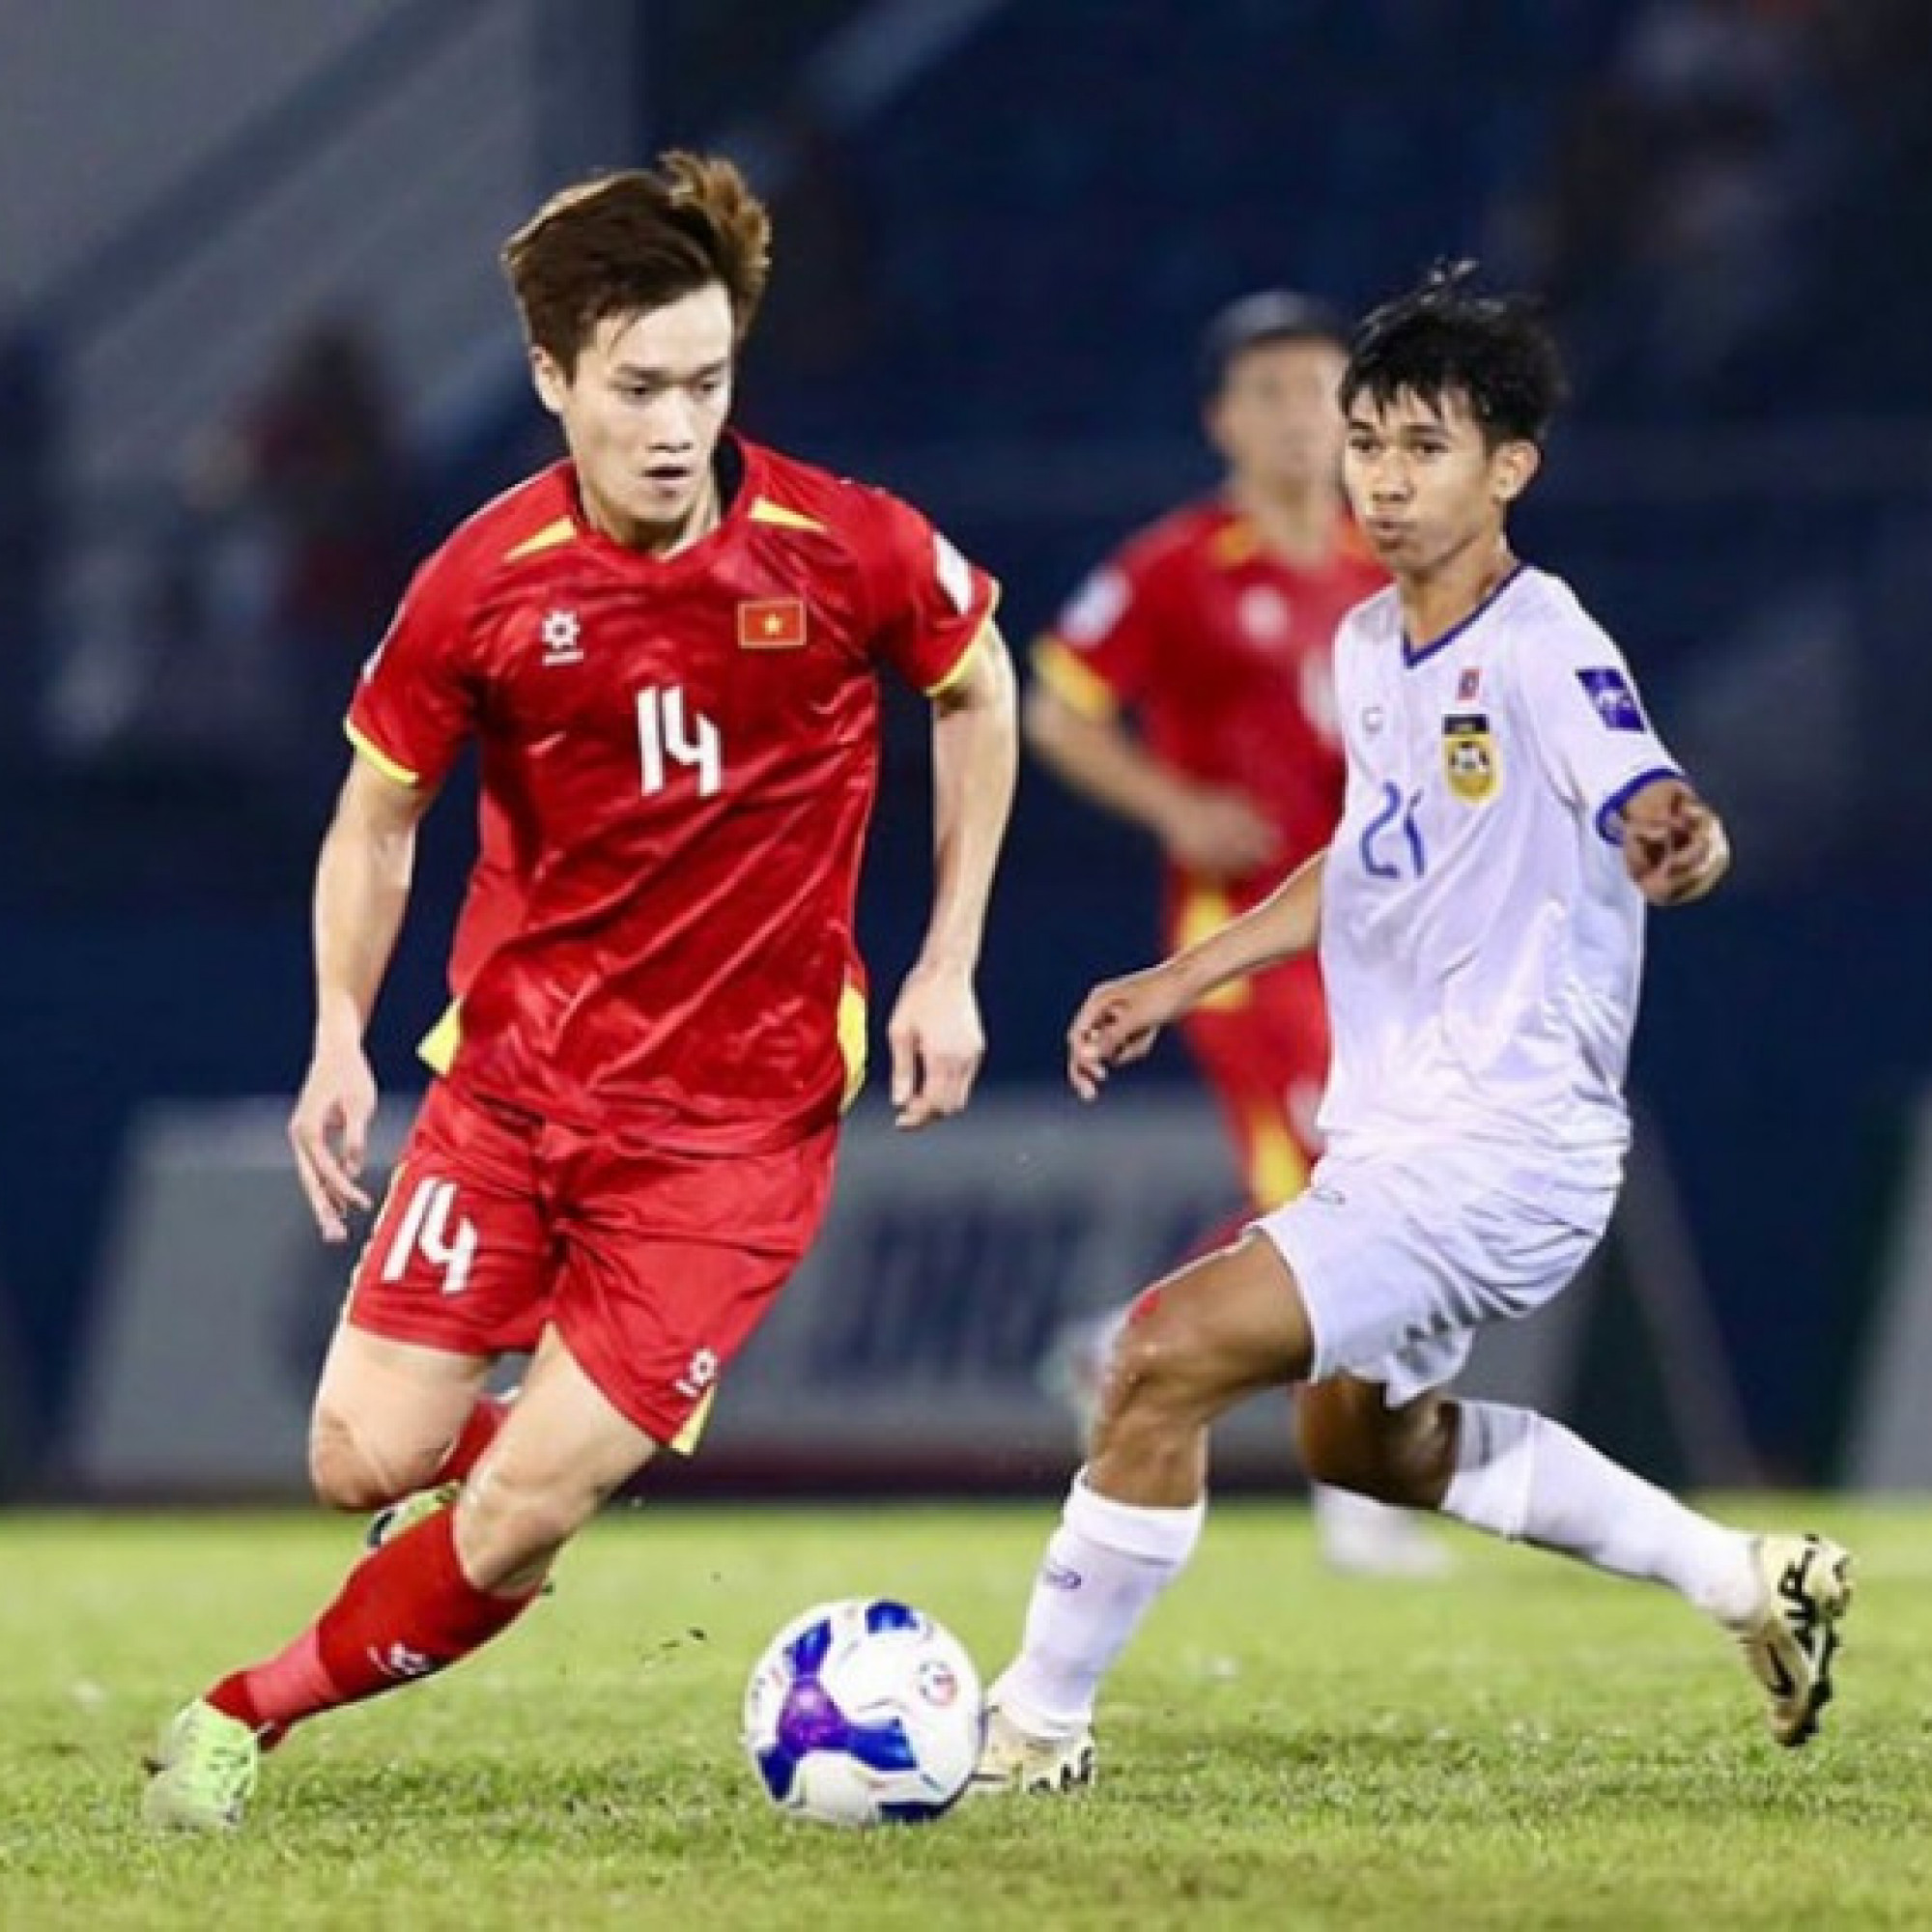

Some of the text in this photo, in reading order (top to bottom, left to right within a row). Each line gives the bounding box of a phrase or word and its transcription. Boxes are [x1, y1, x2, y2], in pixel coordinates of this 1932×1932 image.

[637, 685, 722, 797] 14
[1360, 781, 1426, 878] 21
[381, 1178, 478, 1294] 14
